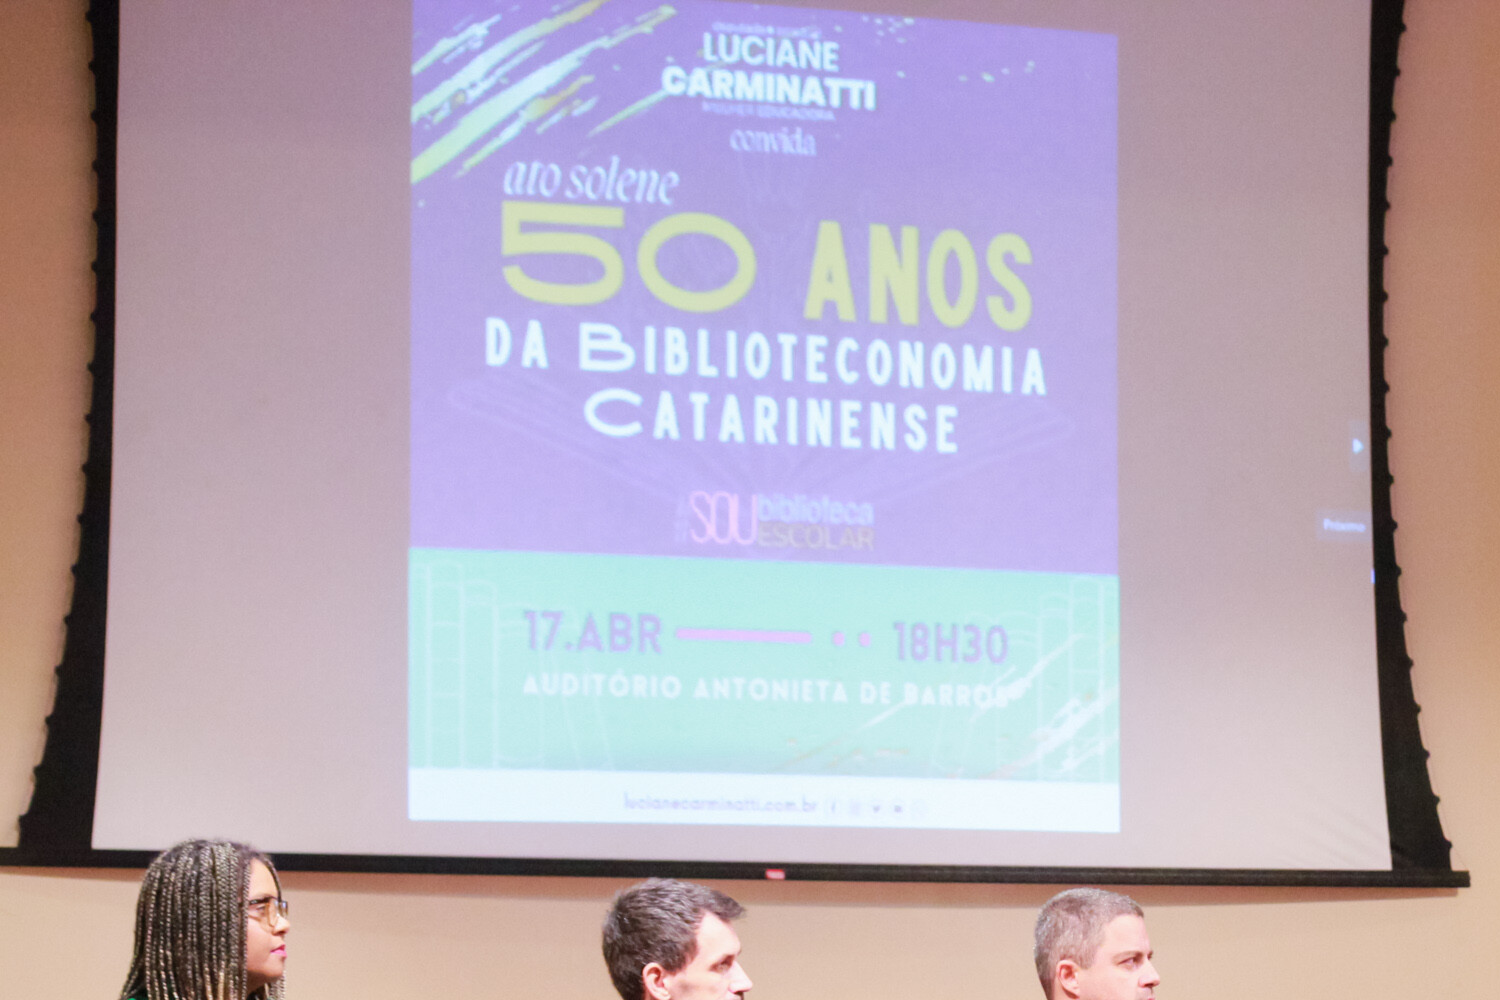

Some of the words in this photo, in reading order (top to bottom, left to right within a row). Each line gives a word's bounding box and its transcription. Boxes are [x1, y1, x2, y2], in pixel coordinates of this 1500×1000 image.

[702, 31, 840, 72] LUCIANE
[661, 65, 877, 111] CARMINATTI
[503, 161, 561, 198] ato
[565, 155, 680, 206] solene
[502, 200, 757, 312] 50
[803, 219, 1033, 332] ANOS
[485, 316, 549, 369] DA
[579, 321, 1047, 396] BIBLIOTECONOMIA
[583, 387, 959, 454] CATARINENSE
[758, 521, 876, 551] ESCOLAR
[524, 609, 663, 655] 17.ABR
[893, 621, 1009, 664] 18H30
[523, 668, 682, 699] AUDITÓRIO
[693, 676, 848, 703] ANTONIETA
[860, 681, 892, 704] DE
